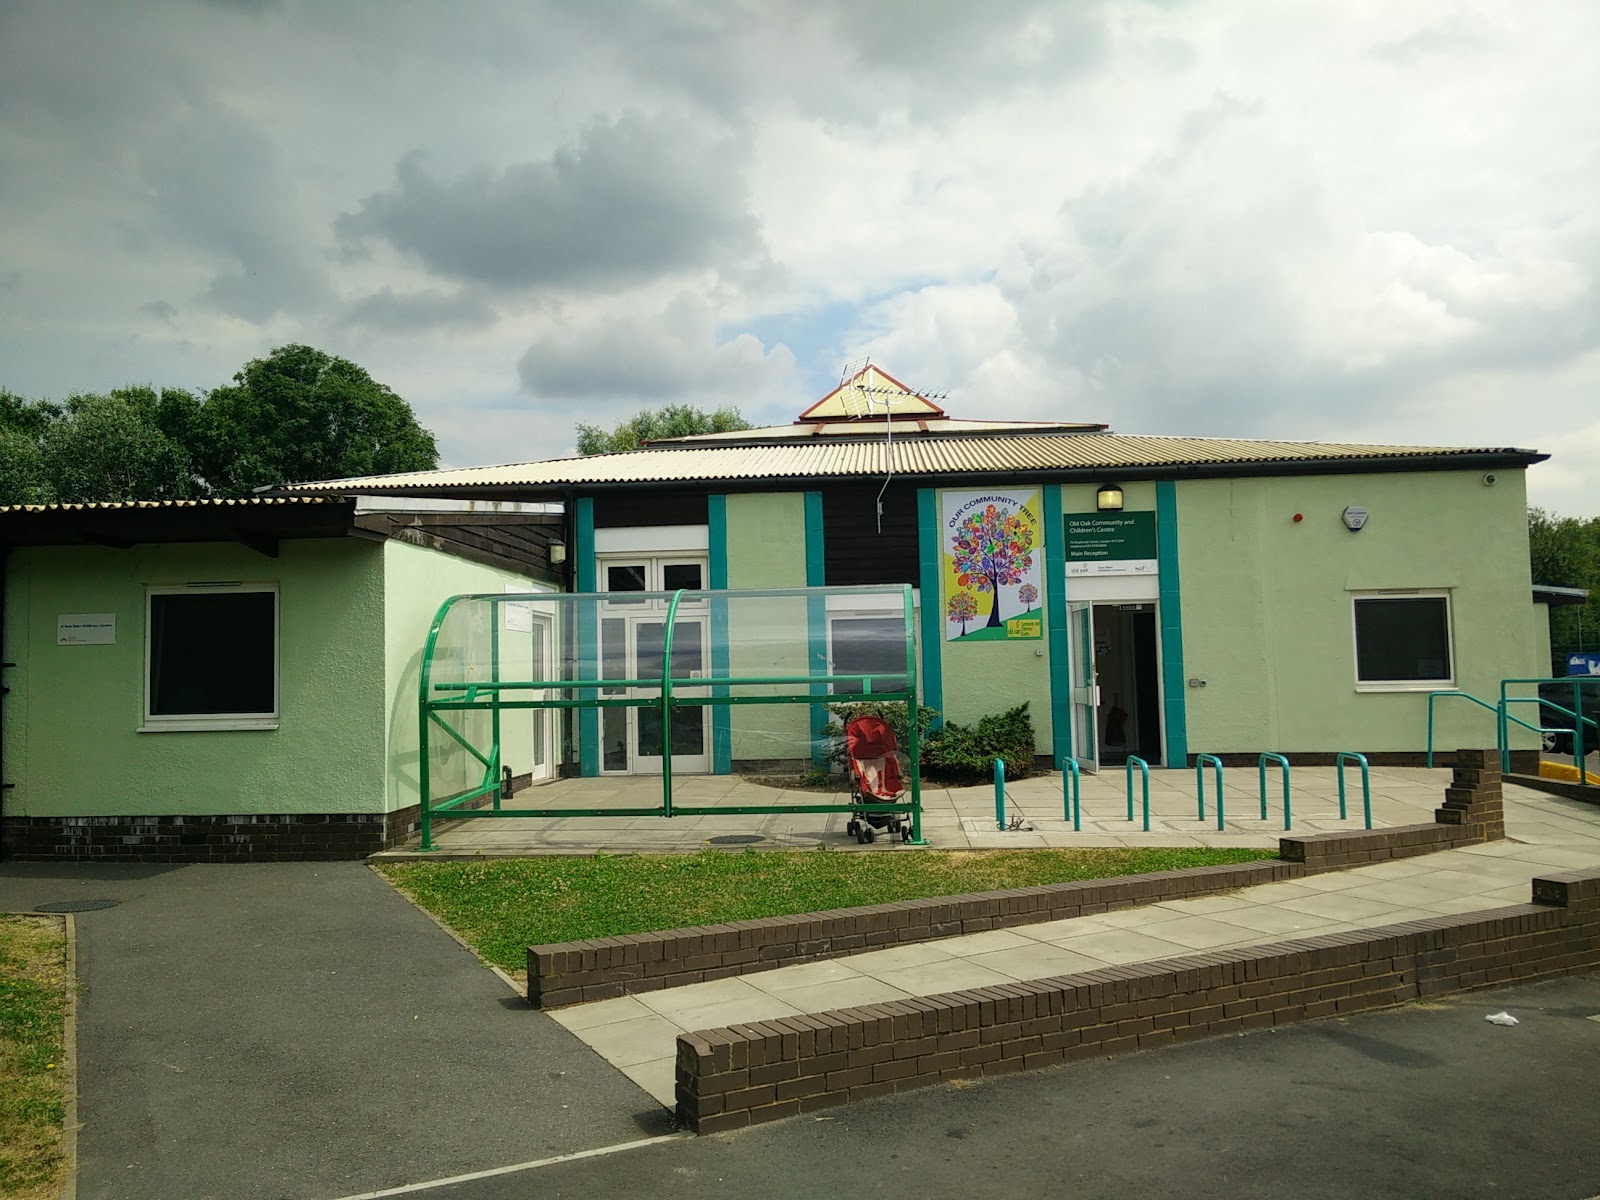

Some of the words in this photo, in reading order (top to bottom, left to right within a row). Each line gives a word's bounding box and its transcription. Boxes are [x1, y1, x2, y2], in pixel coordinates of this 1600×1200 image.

[949, 508, 964, 528] OUR
[963, 496, 1018, 510] COMMUNITY
[1019, 504, 1037, 526] TREE
